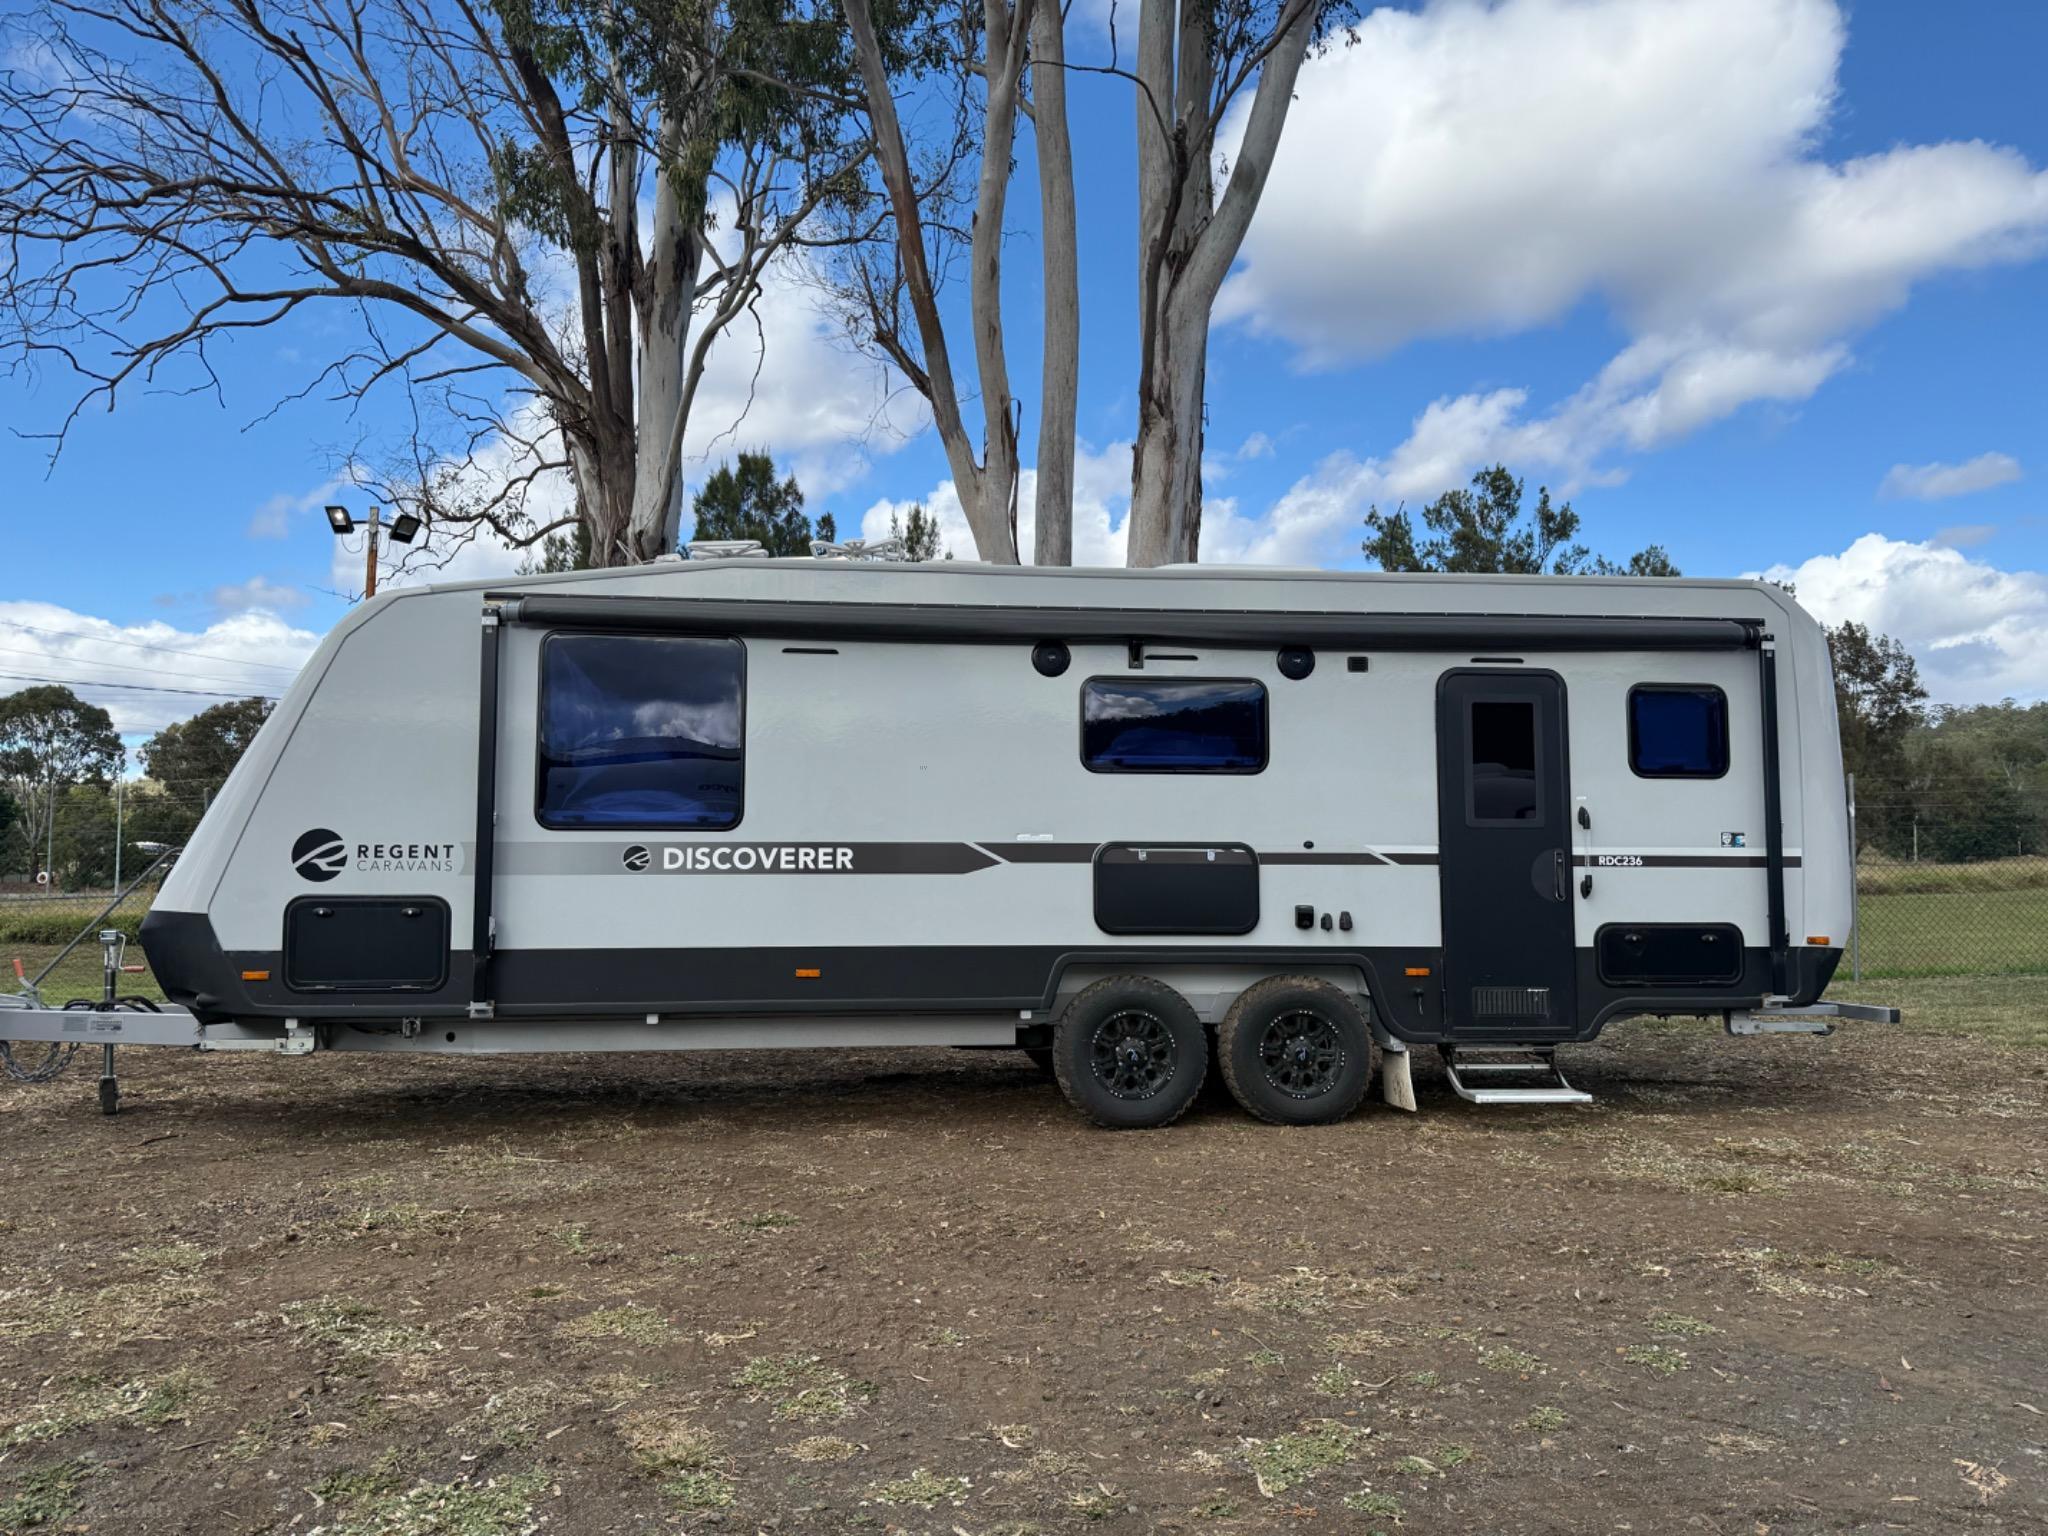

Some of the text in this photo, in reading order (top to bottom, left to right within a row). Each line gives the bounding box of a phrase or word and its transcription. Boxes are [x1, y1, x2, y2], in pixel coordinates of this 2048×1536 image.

[357, 844, 454, 859] REGENT
[663, 847, 854, 870] DISCOVERER
[1598, 855, 1643, 866] RDC236
[356, 860, 453, 872] CARAVANS
